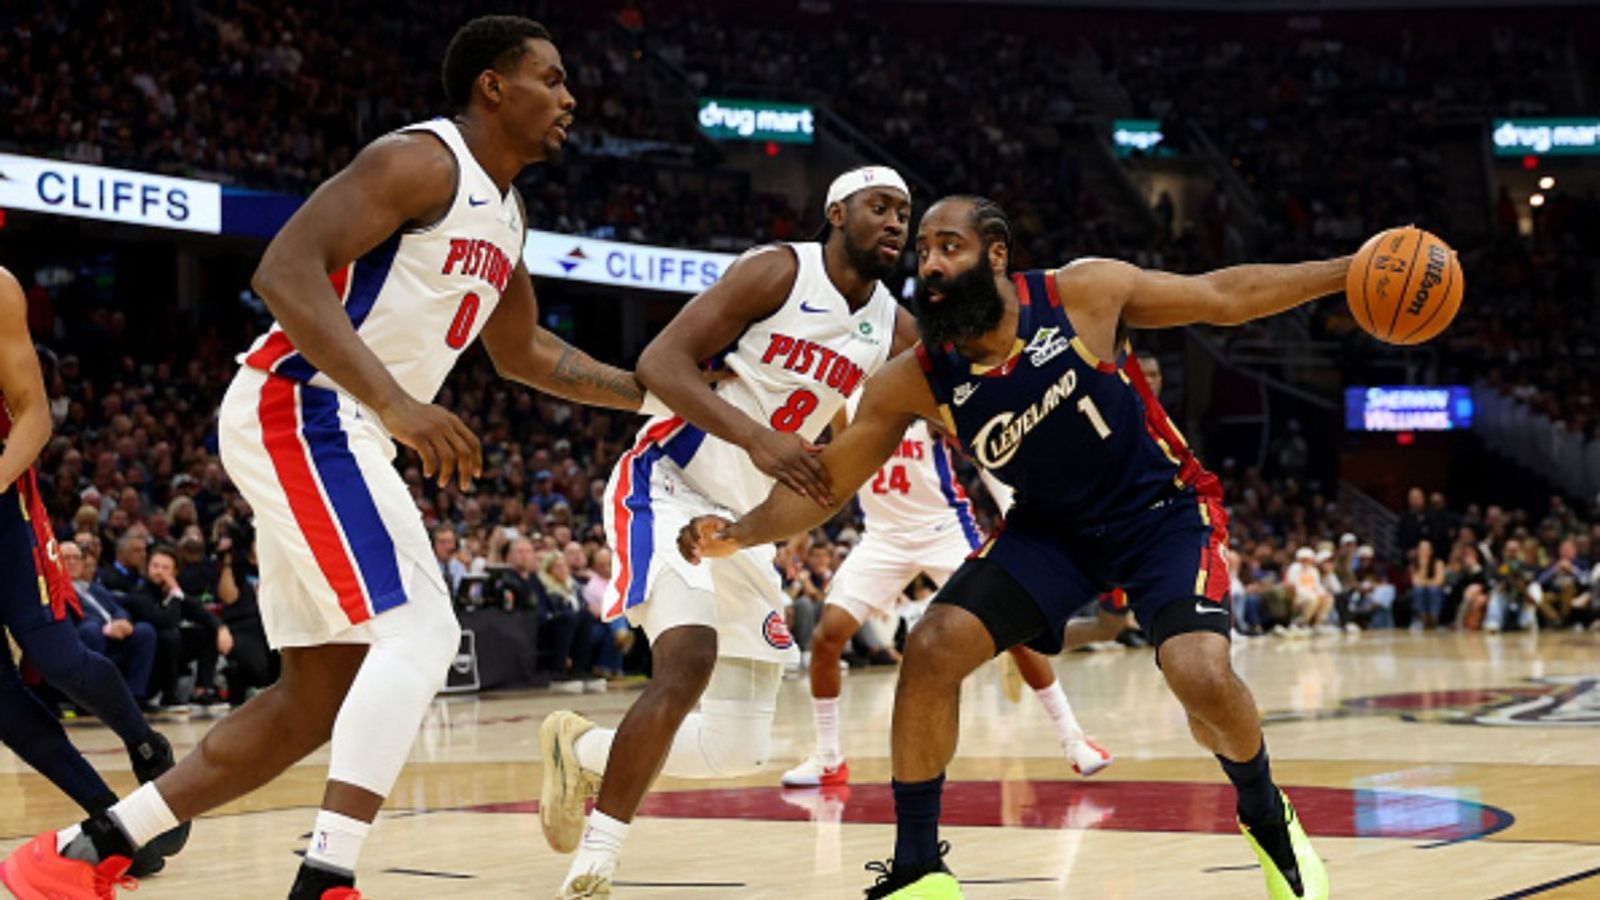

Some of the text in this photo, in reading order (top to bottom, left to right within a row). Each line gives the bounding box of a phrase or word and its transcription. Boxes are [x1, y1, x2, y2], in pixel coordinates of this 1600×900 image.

[699, 101, 814, 135] drug mart
[1494, 122, 1551, 152] drug
[37, 171, 190, 222] CLIFFS
[606, 252, 718, 286] CLIFFS
[446, 292, 480, 349] 0
[761, 333, 868, 398] PISTON
[770, 387, 819, 432] 8
[1077, 395, 1112, 440] 1
[872, 466, 911, 495] 24
